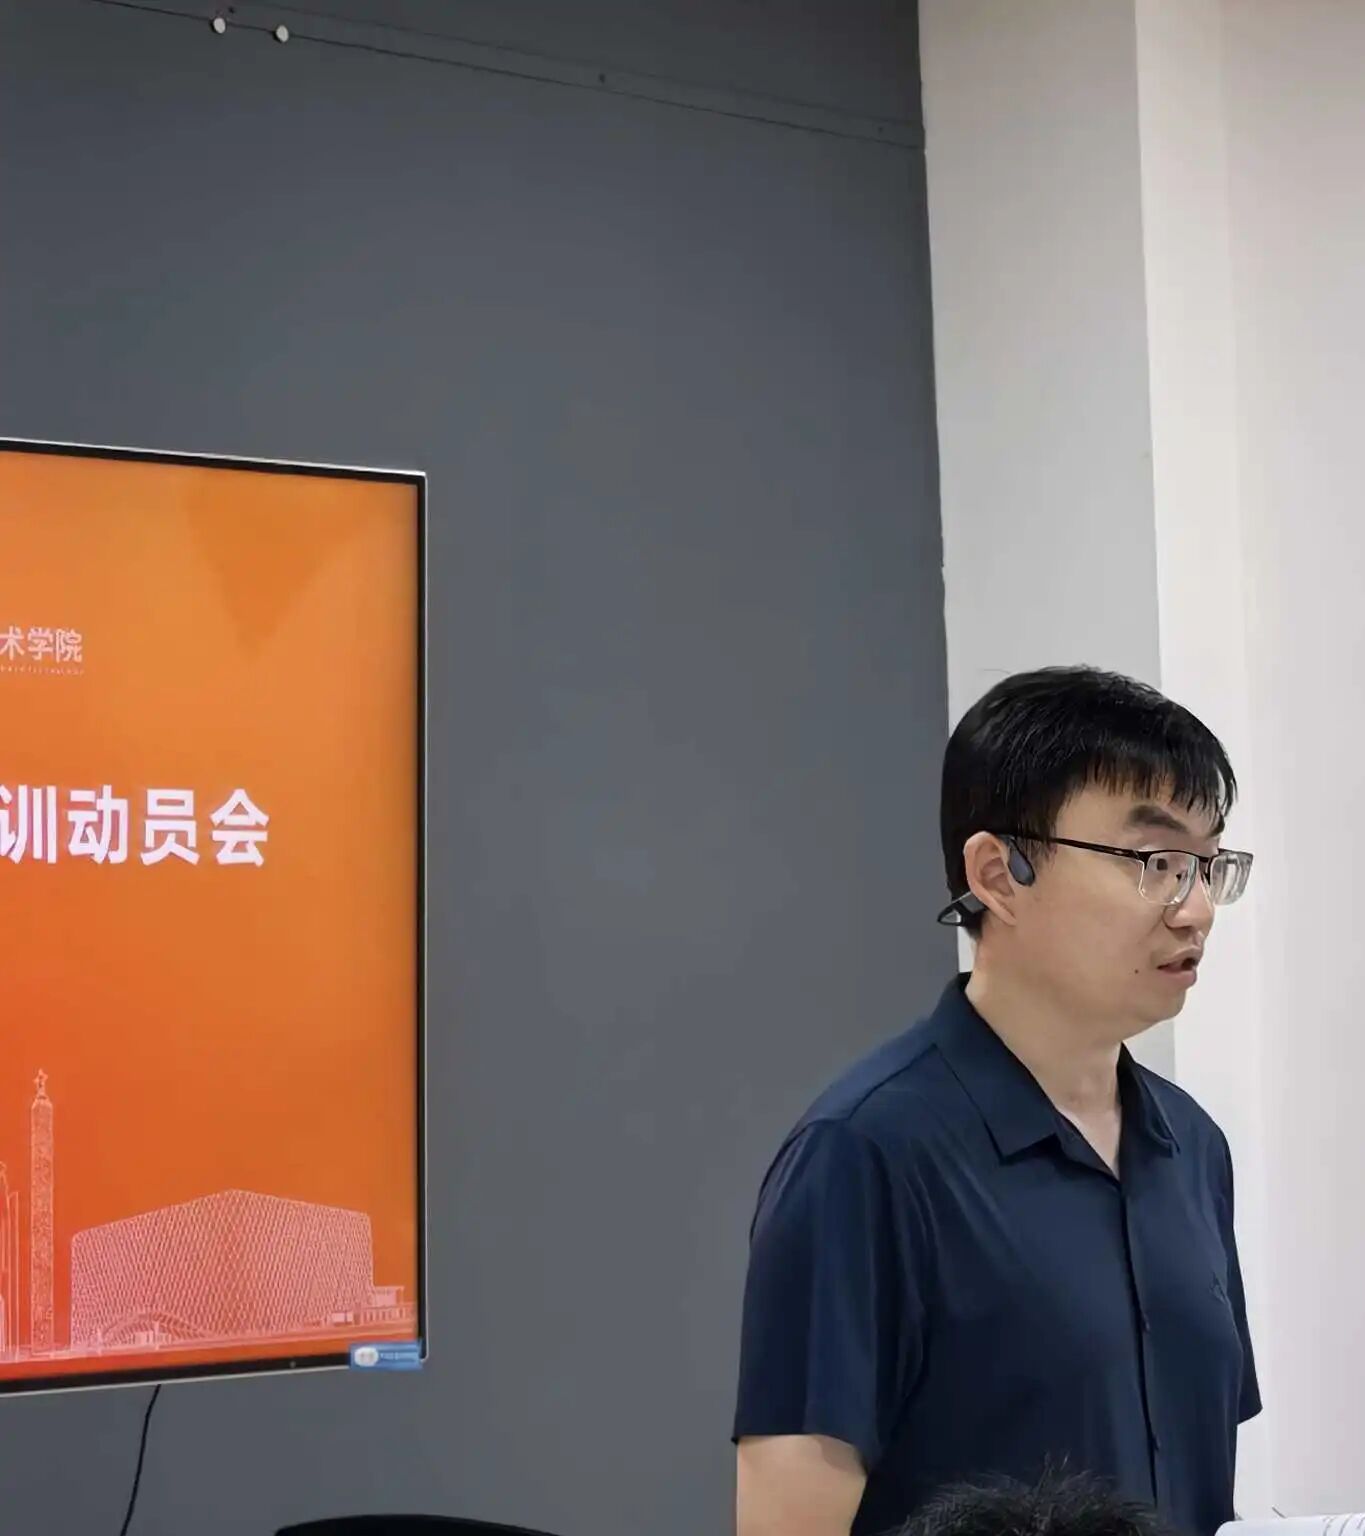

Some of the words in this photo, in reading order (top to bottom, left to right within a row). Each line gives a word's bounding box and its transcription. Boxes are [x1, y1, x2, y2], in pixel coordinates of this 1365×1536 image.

[0, 626, 82, 663] 术学院
[0, 785, 269, 866] 训动员会
